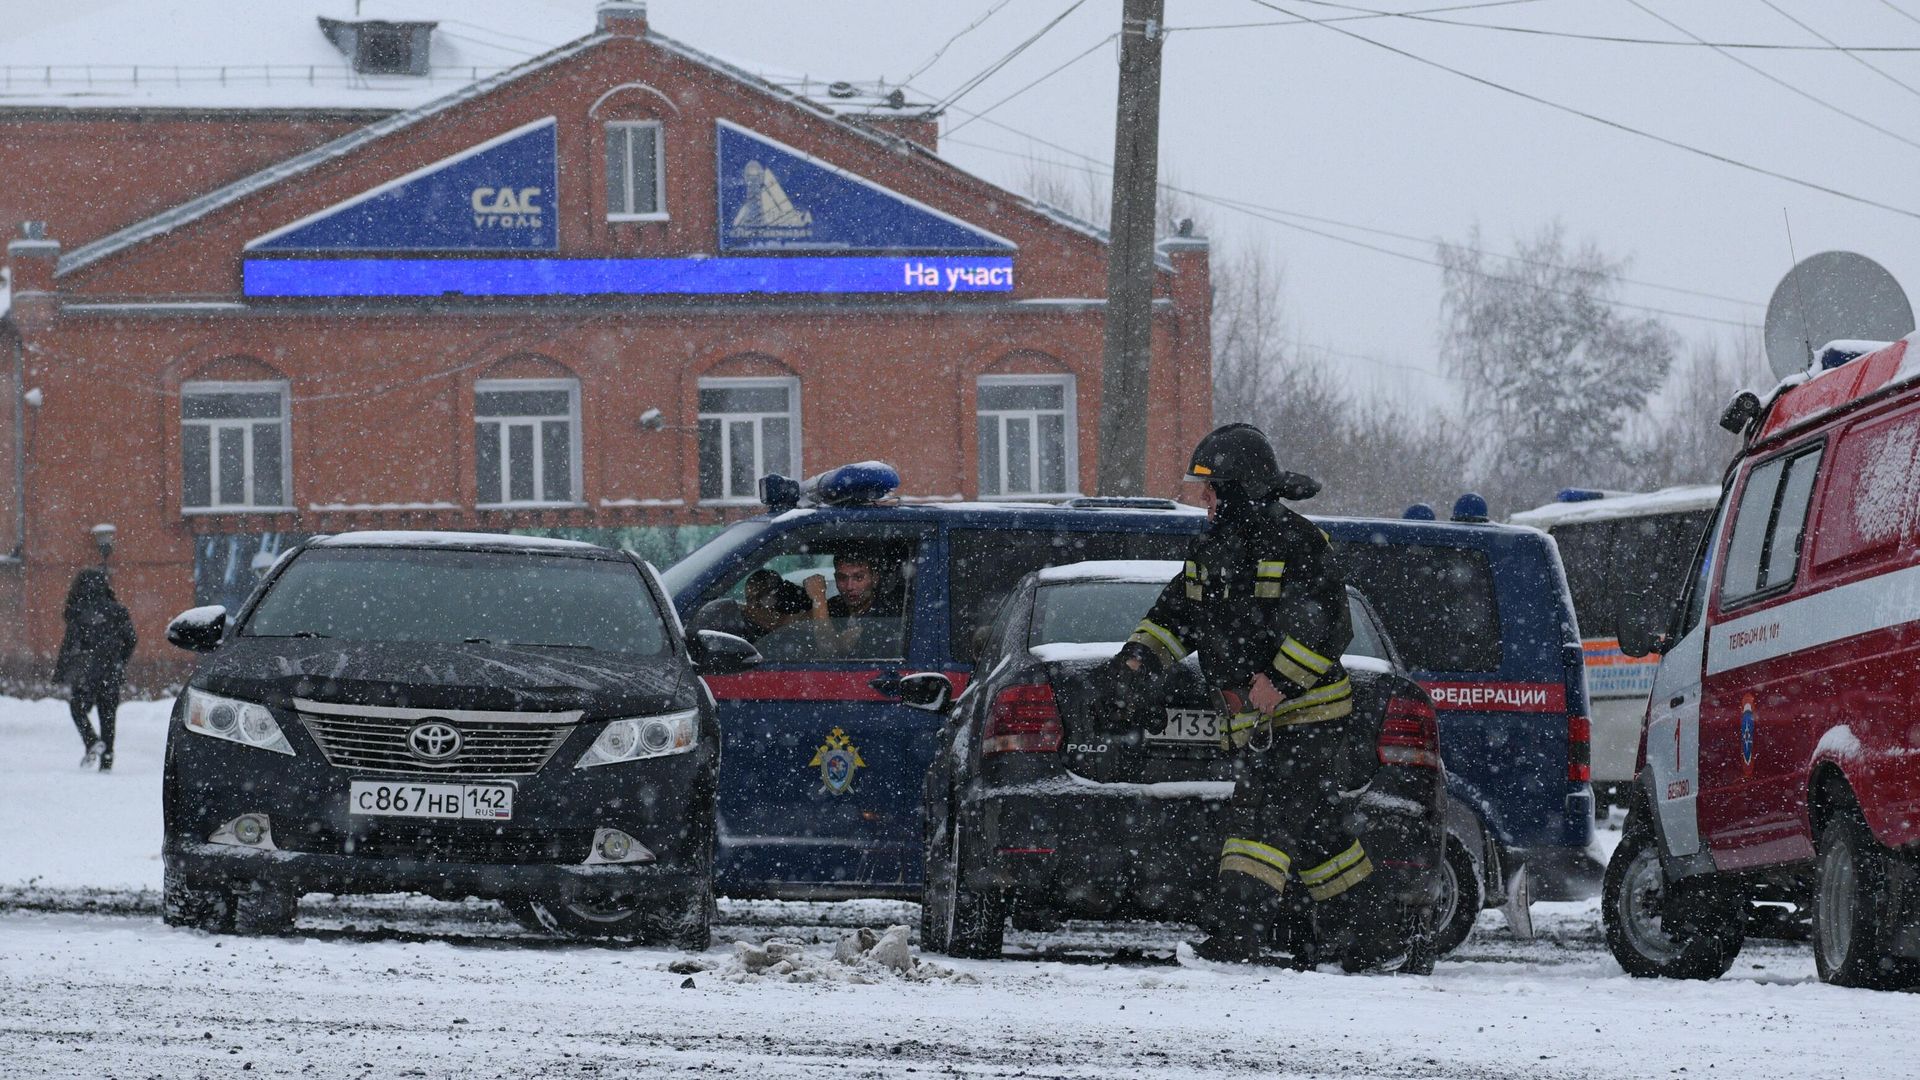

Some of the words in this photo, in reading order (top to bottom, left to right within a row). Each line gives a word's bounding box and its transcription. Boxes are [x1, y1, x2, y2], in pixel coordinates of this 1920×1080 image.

[474, 215, 542, 228] УГОЛЬ
[904, 262, 939, 286] На
[945, 267, 1013, 292] участ
[1729, 627, 1759, 651] ТЕЛЕФОН
[1769, 622, 1780, 639] 101
[1431, 687, 1547, 707] ФЕДЕРАЦИИ
[1161, 712, 1217, 737] 133
[1066, 743, 1108, 753] POLO
[1674, 717, 1681, 774] 1
[467, 788, 506, 808] 142
[474, 808, 495, 816] RUS
